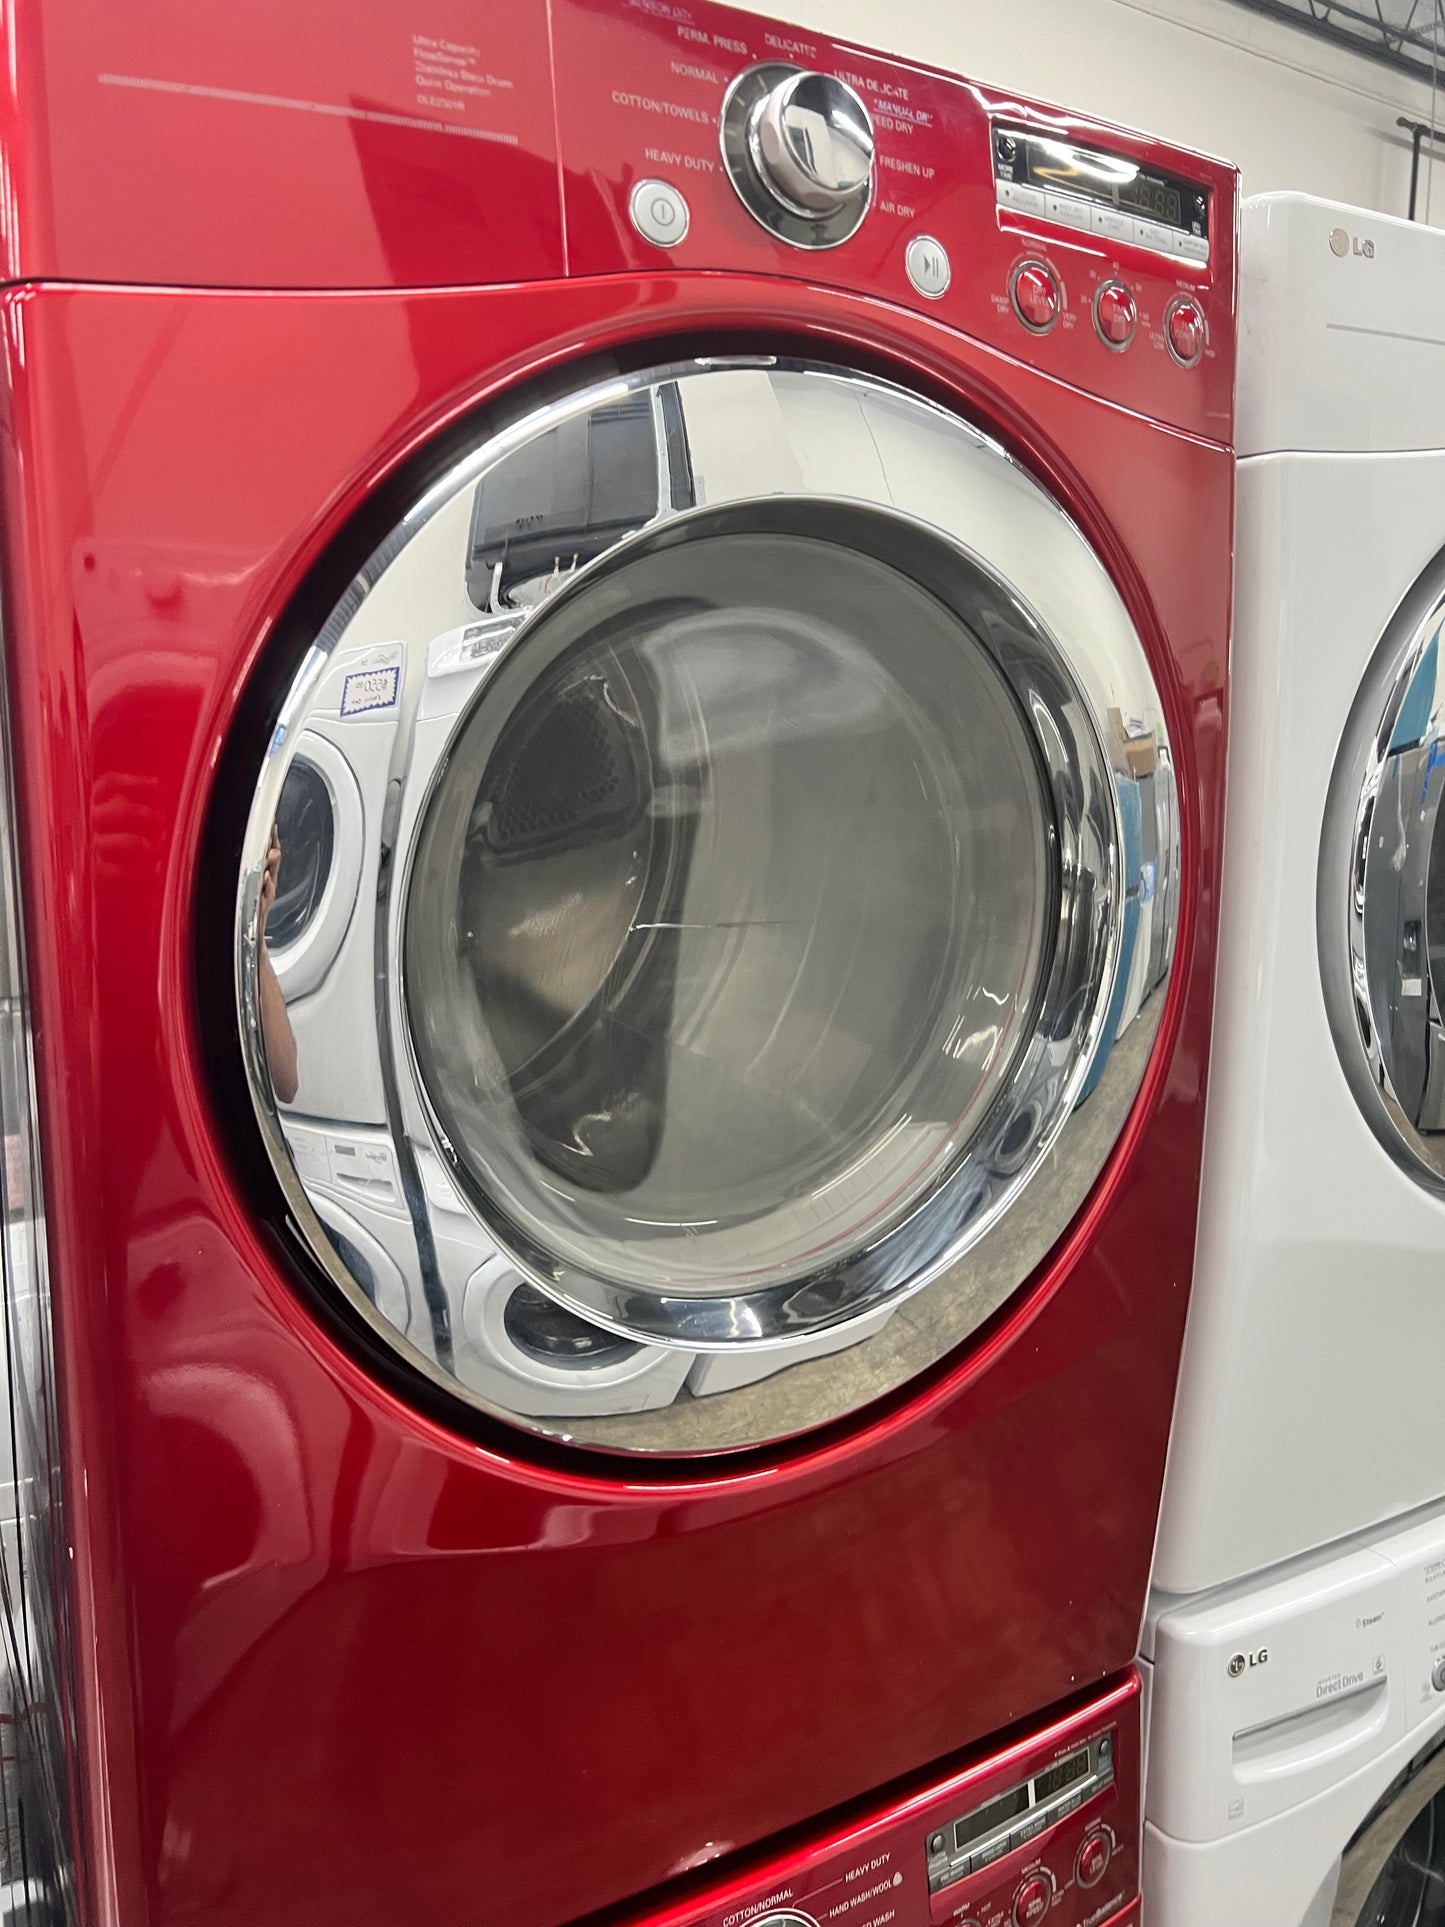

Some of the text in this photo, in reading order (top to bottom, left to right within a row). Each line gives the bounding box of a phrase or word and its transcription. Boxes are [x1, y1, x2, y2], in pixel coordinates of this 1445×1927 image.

[677, 25, 748, 55] PERM. PRESS
[670, 61, 719, 84] NORMAL
[834, 69, 865, 88] ULTRA
[612, 90, 709, 125] COTTON/TOWELS
[895, 120, 914, 135] DRY
[645, 148, 714, 173] HEAVY DUTY
[879, 156, 935, 179] FRESHEN UP
[880, 201, 915, 219] AIR DRY
[1352, 236, 1375, 258] LG
[1249, 1649, 1268, 1667] LG
[1316, 1672, 1364, 1698] Direct Drive
[845, 1853, 890, 1882] HEAVY DUTY
[722, 1888, 794, 1927] COTTON/NORMAL
[829, 1879, 892, 1918] HAND WASH/WOOL
[874, 1909, 895, 1926] WASH
